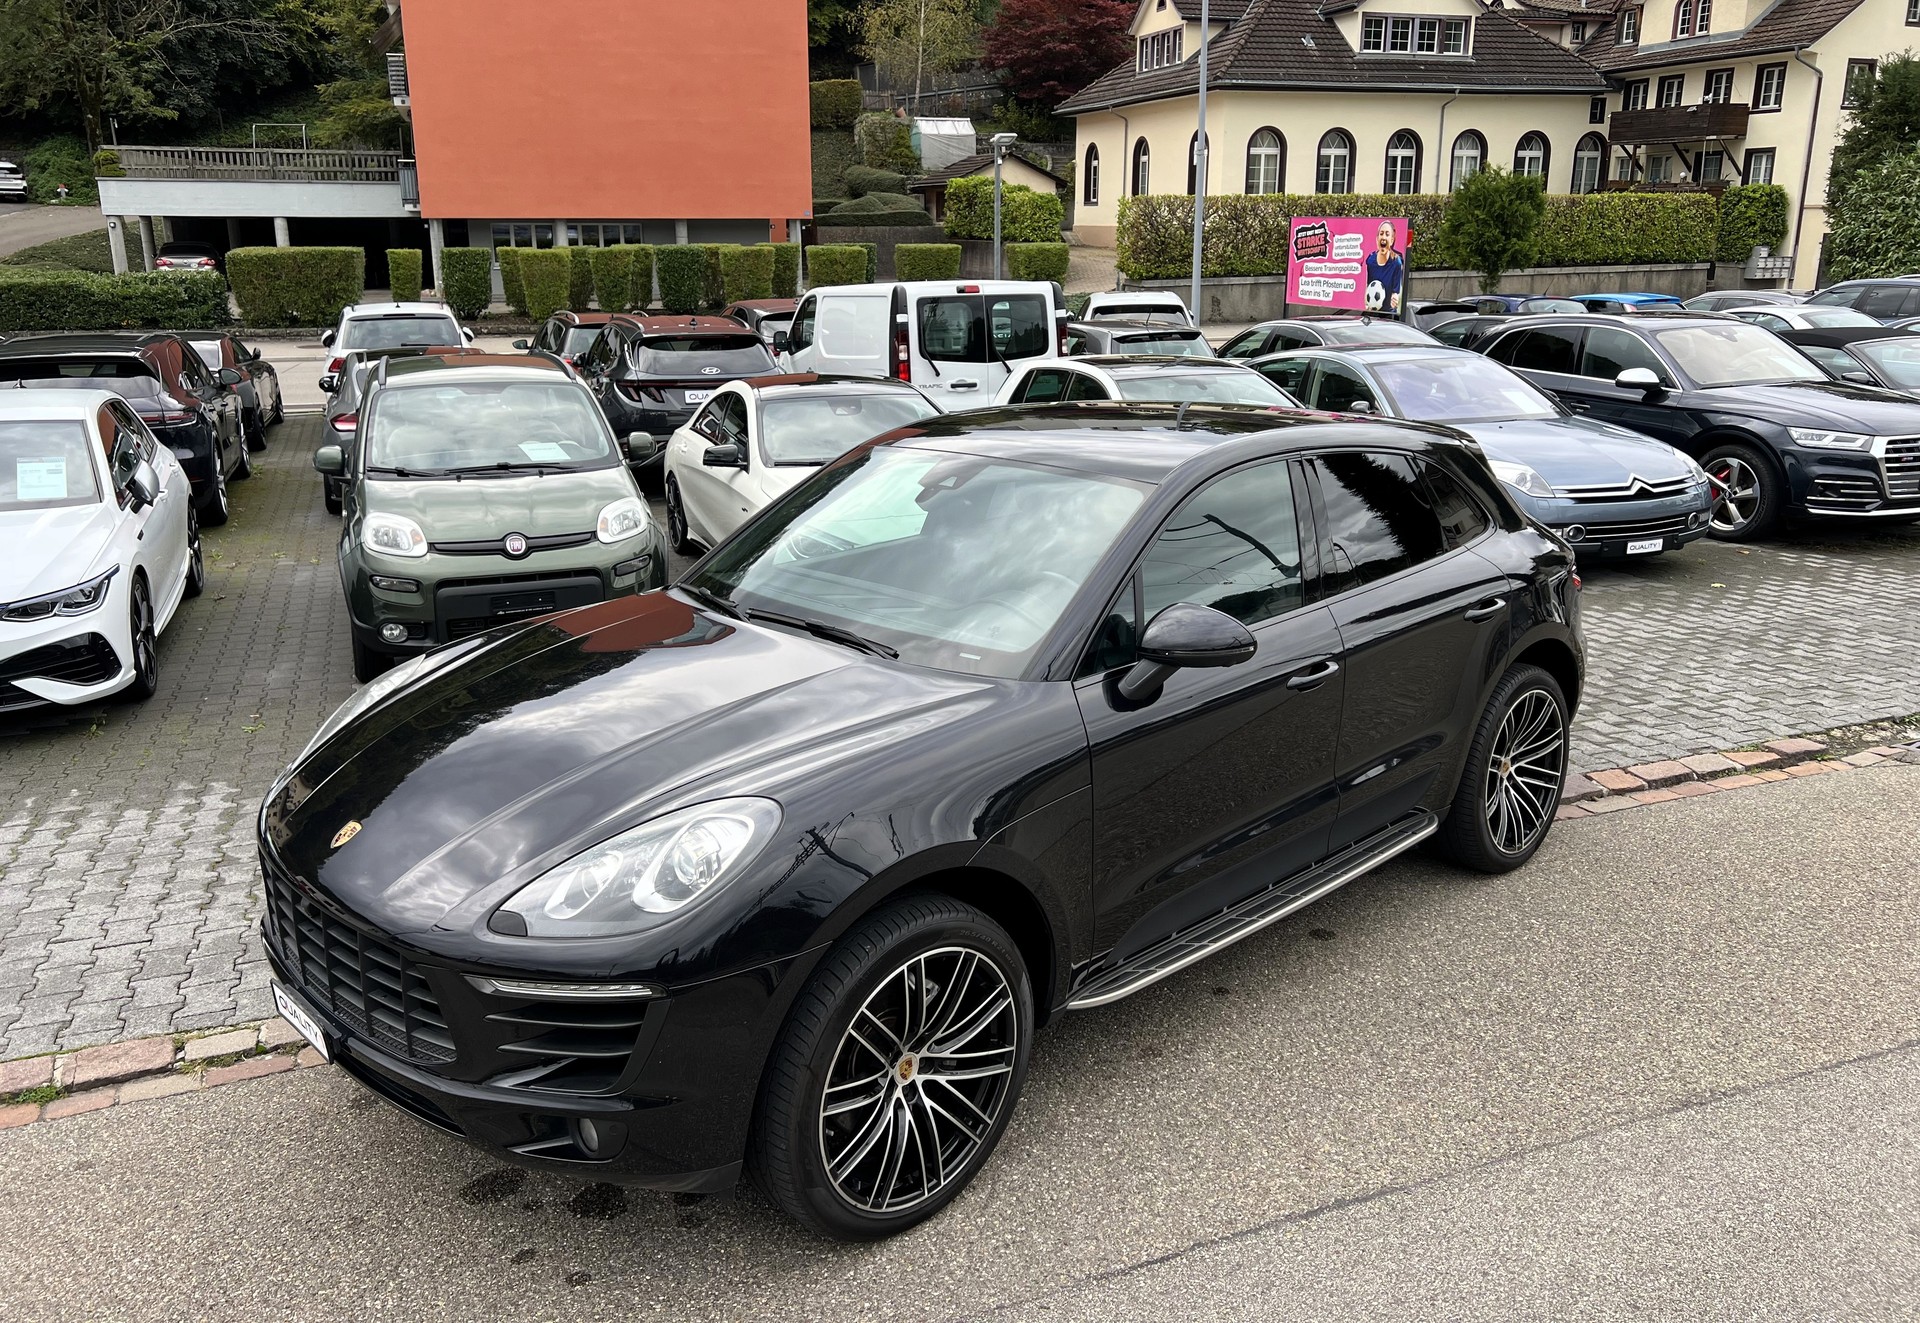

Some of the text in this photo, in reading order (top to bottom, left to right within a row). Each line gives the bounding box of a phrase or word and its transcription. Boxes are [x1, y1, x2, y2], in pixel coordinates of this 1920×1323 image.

[1297, 234, 1325, 249] STARKE
[1300, 278, 1310, 286] Lea
[1311, 279, 1322, 287] trifft
[1323, 280, 1342, 288] Pfosten
